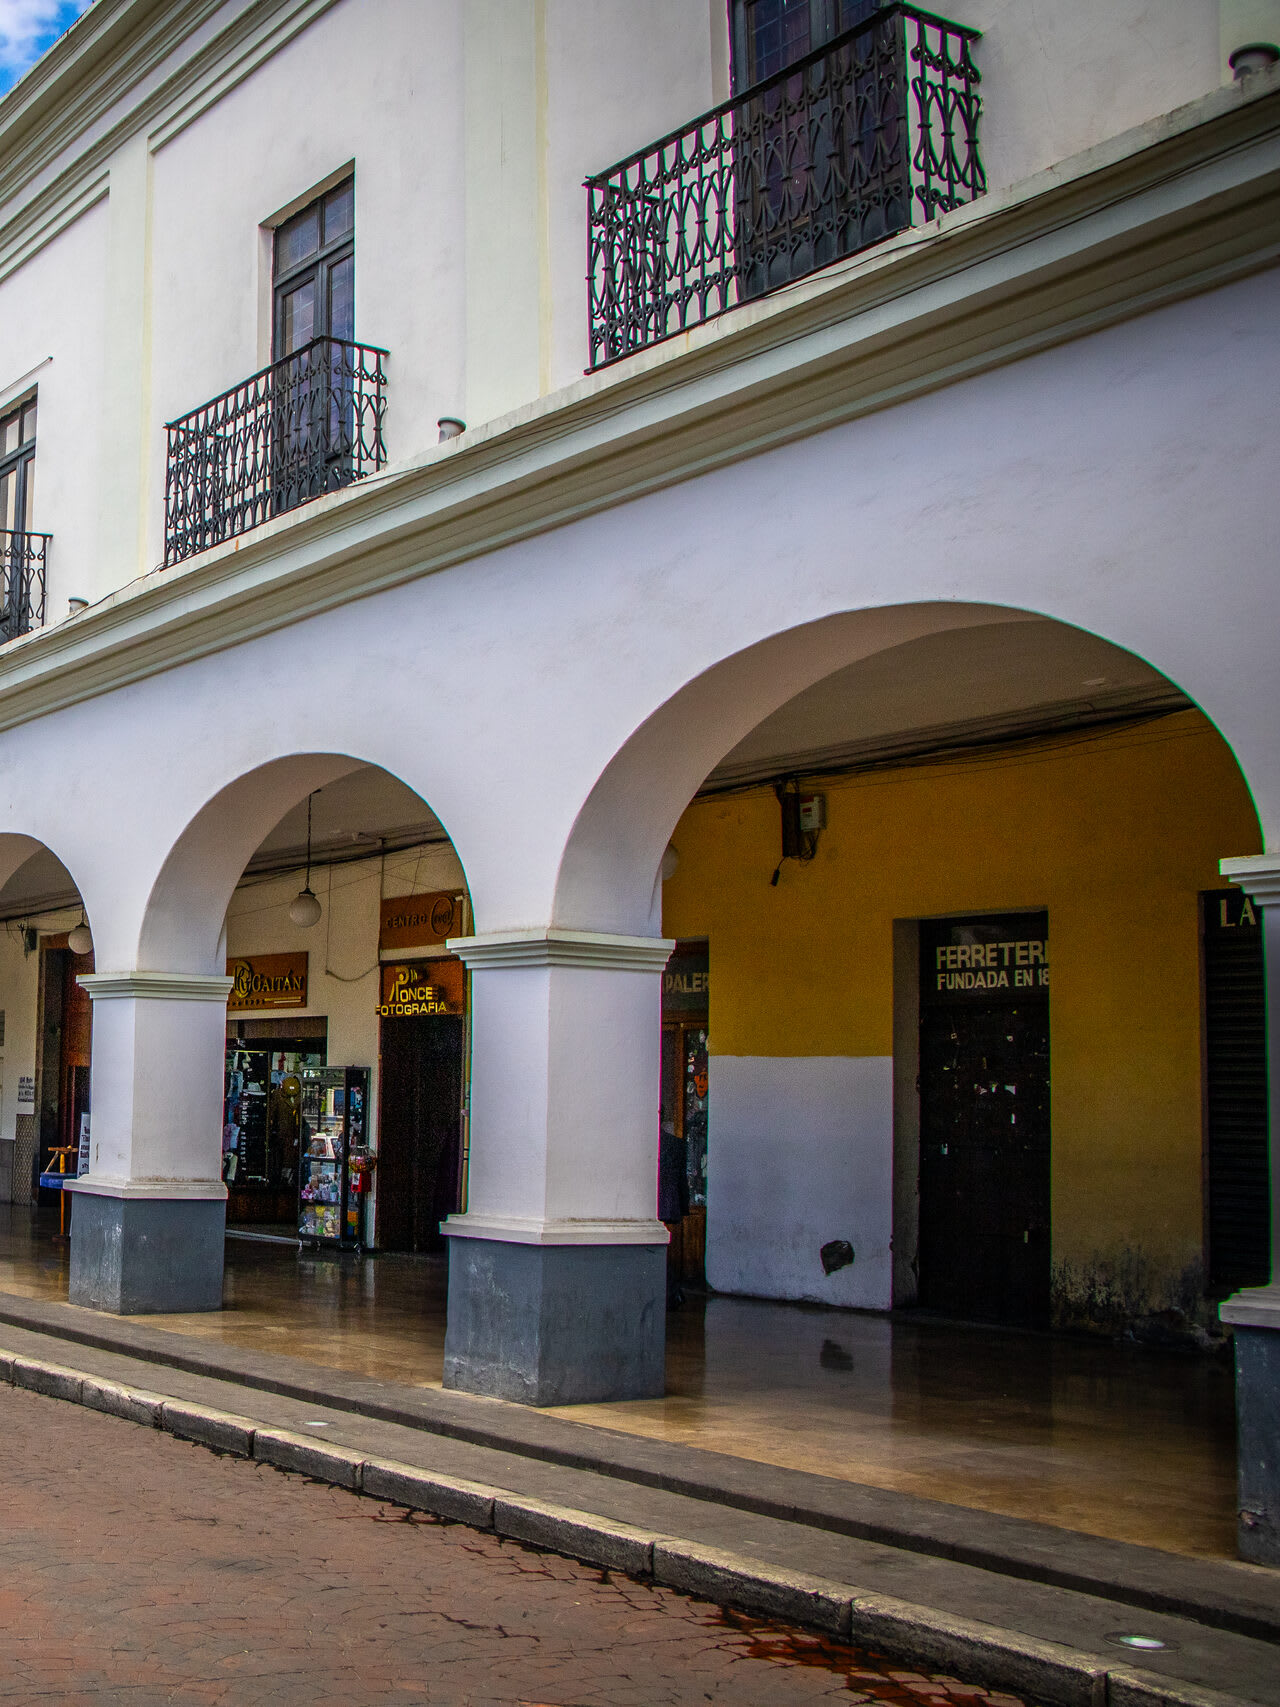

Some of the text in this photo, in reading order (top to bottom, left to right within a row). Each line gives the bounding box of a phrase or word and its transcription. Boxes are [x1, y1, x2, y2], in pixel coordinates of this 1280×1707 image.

[386, 914, 426, 928] CENTRO
[1219, 896, 1256, 928] LA
[388, 967, 433, 1003] PONCE
[936, 970, 1009, 991] FUNDADA
[1014, 969, 1034, 987] EN
